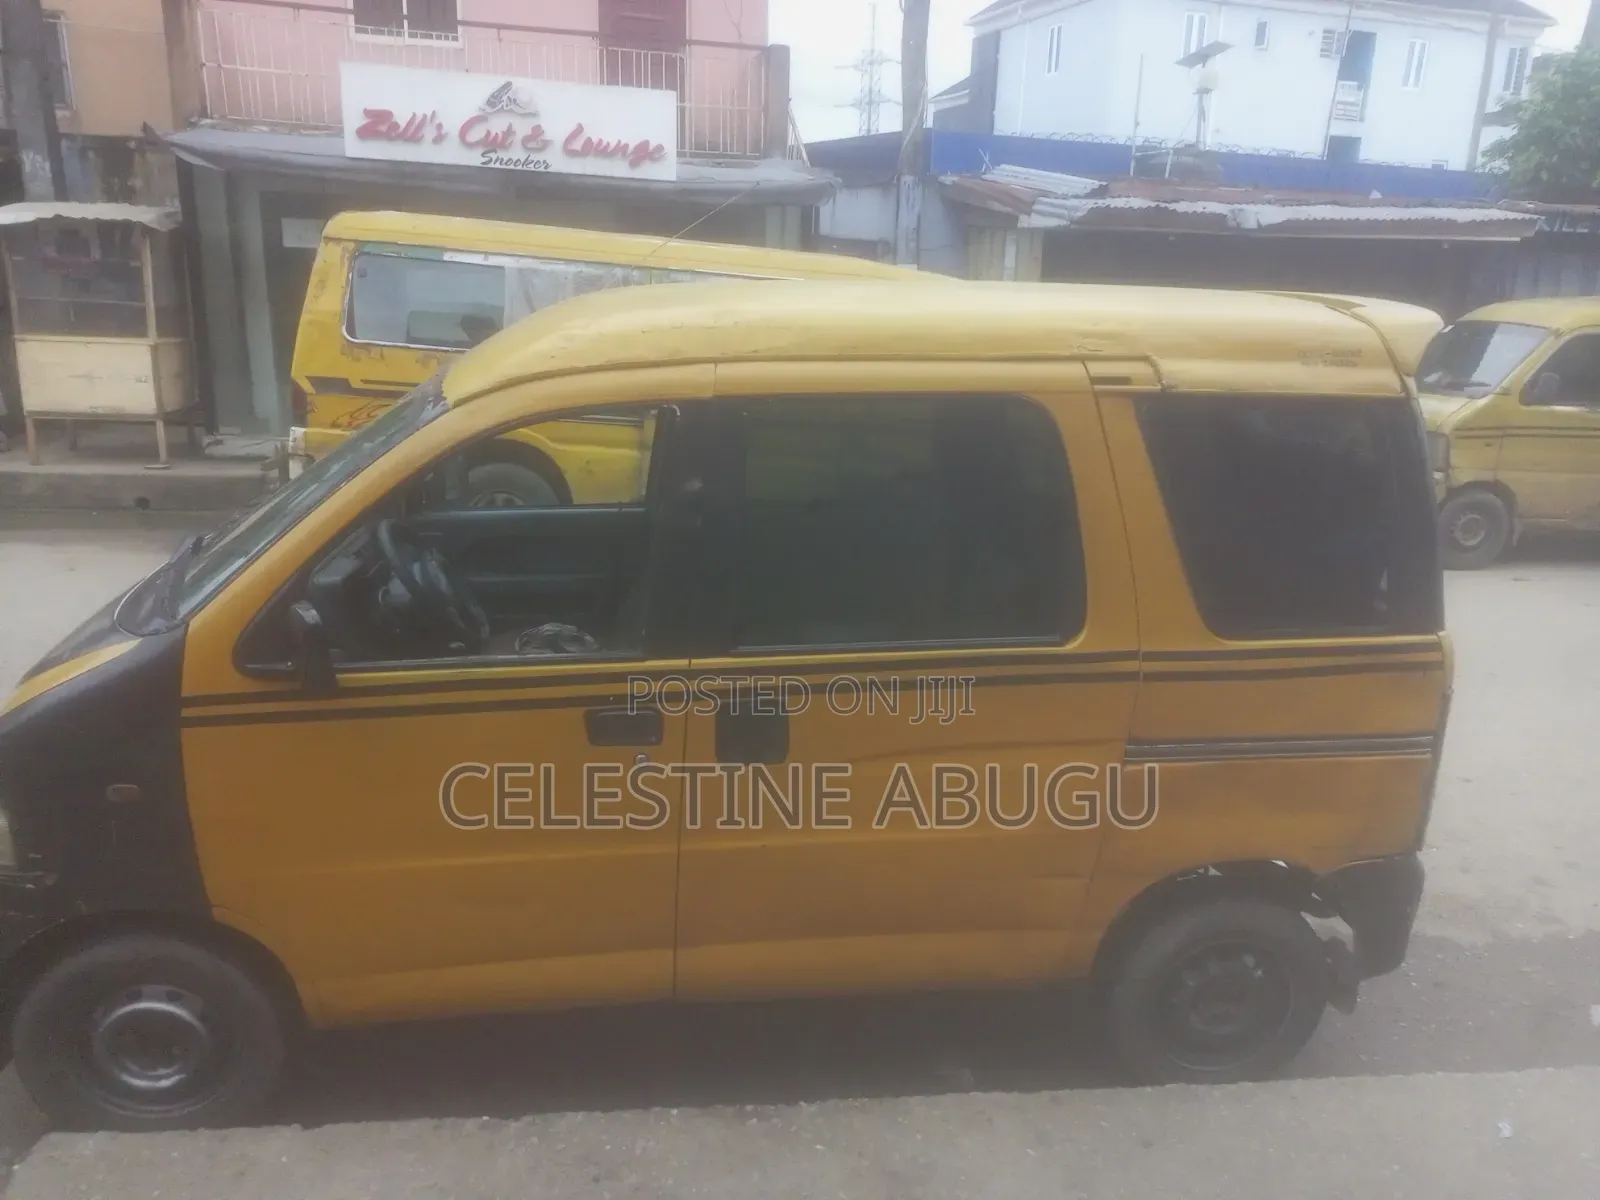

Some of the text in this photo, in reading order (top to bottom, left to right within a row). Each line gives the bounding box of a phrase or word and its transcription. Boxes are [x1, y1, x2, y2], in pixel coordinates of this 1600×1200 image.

[459, 114, 516, 148] Cut
[521, 124, 553, 152] &
[563, 122, 668, 169] Lounge
[480, 149, 551, 170] Snooker
